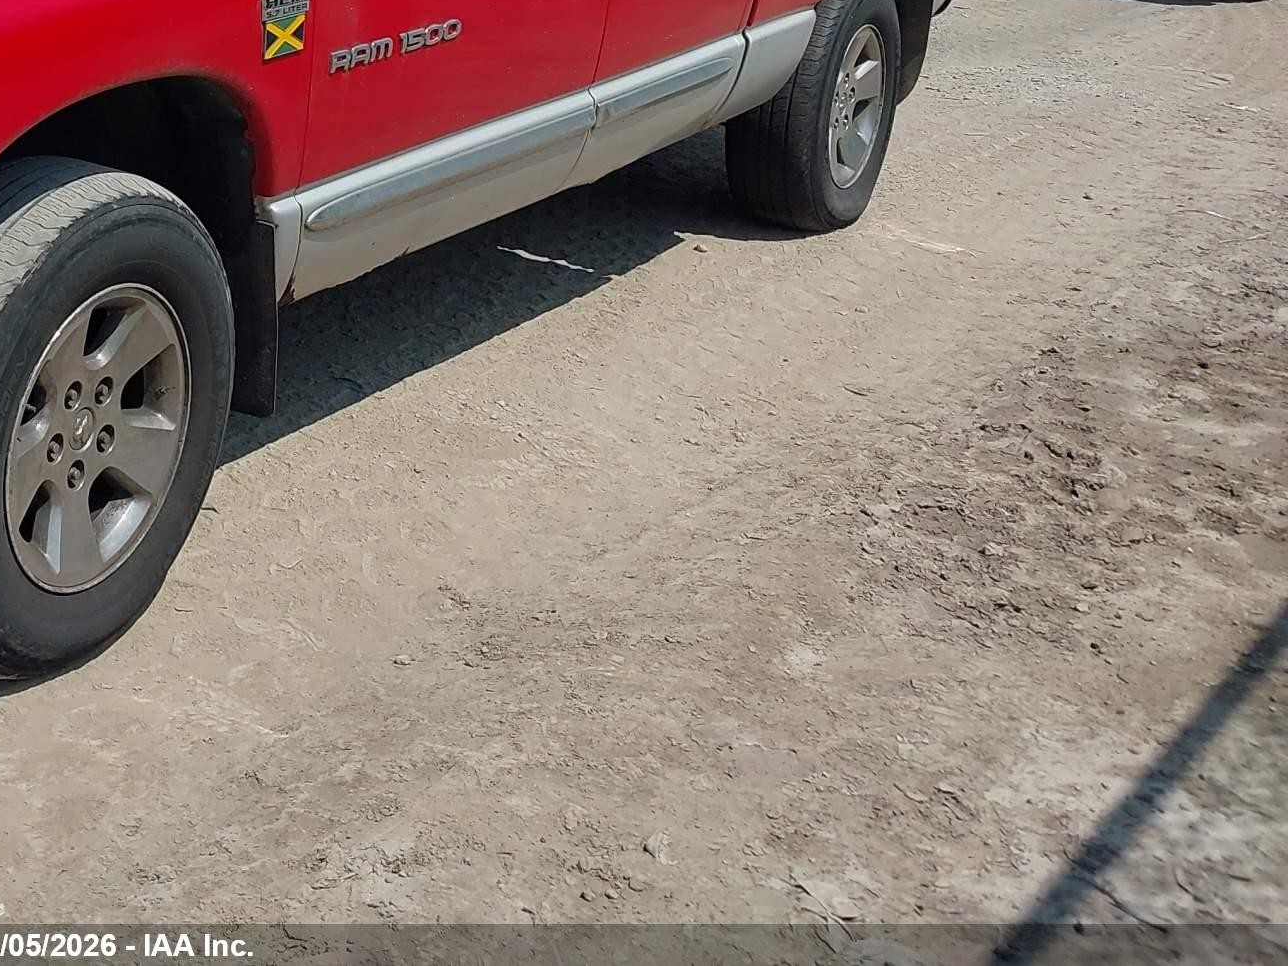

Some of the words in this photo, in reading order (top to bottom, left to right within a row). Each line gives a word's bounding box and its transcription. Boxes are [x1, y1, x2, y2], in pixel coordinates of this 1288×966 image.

[282, 2, 308, 15] LITER
[329, 37, 393, 74] RAM
[399, 19, 462, 54] 1500
